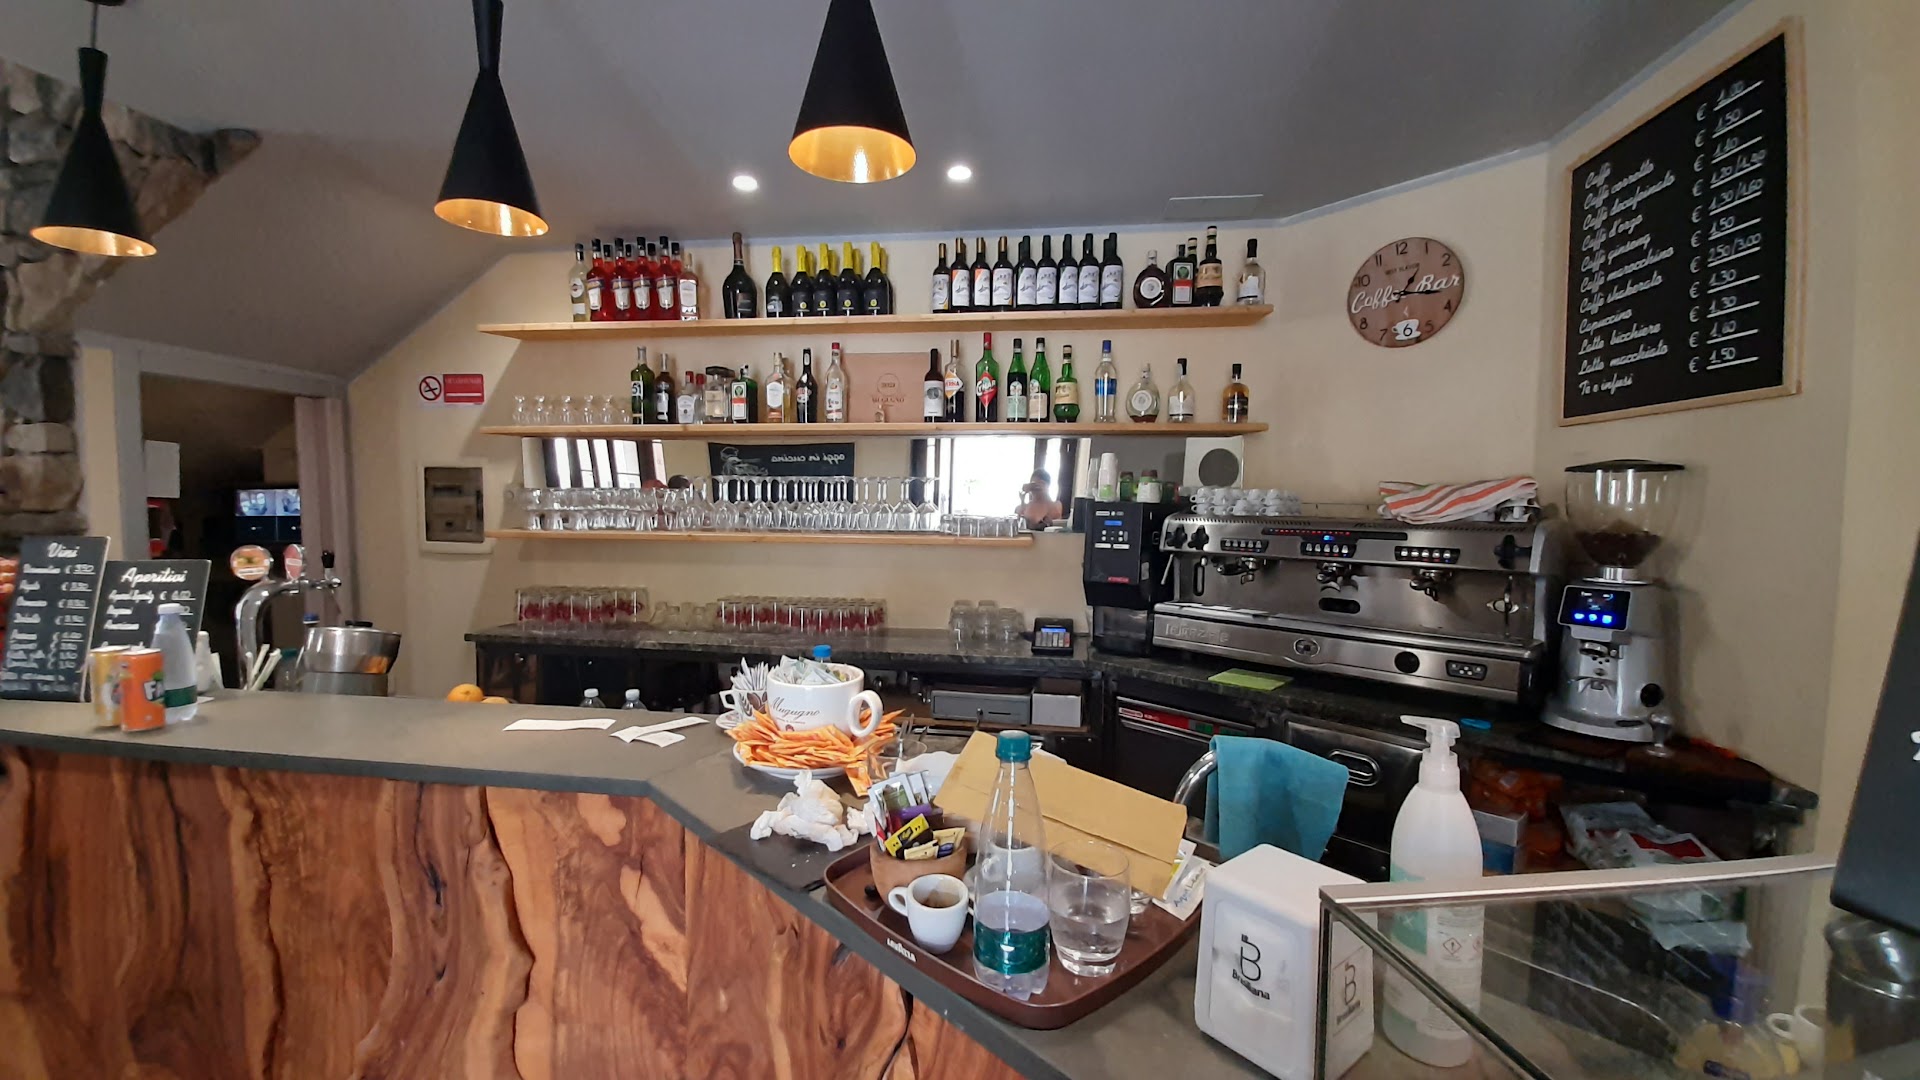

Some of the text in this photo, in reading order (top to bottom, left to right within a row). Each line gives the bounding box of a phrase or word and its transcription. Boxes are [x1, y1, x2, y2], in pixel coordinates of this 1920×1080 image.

[1696, 102, 1707, 121] €
[1695, 129, 1706, 147] €
[1693, 154, 1705, 172] €
[1692, 179, 1704, 197] €
[1691, 205, 1703, 223] €
[1690, 230, 1702, 248] €
[1395, 241, 1408, 256] 12
[1375, 254, 1382, 266] 11
[1442, 252, 1451, 266] 2
[1690, 255, 1701, 273] €
[1689, 281, 1700, 298] €
[1360, 317, 1368, 330] 8
[1403, 323, 1413, 337] 6
[1578, 335, 1604, 355] Latte
[1689, 305, 1700, 323] €
[1380, 329, 1388, 340] 7
[1578, 355, 1604, 375] Latte
[1609, 339, 1669, 367] macchiato
[1689, 331, 1699, 348] €
[1688, 356, 1699, 373] €
[47, 543, 80, 558] Vini
[121, 567, 188, 587] Aperitivi
[773, 696, 820, 720] Mugugno
